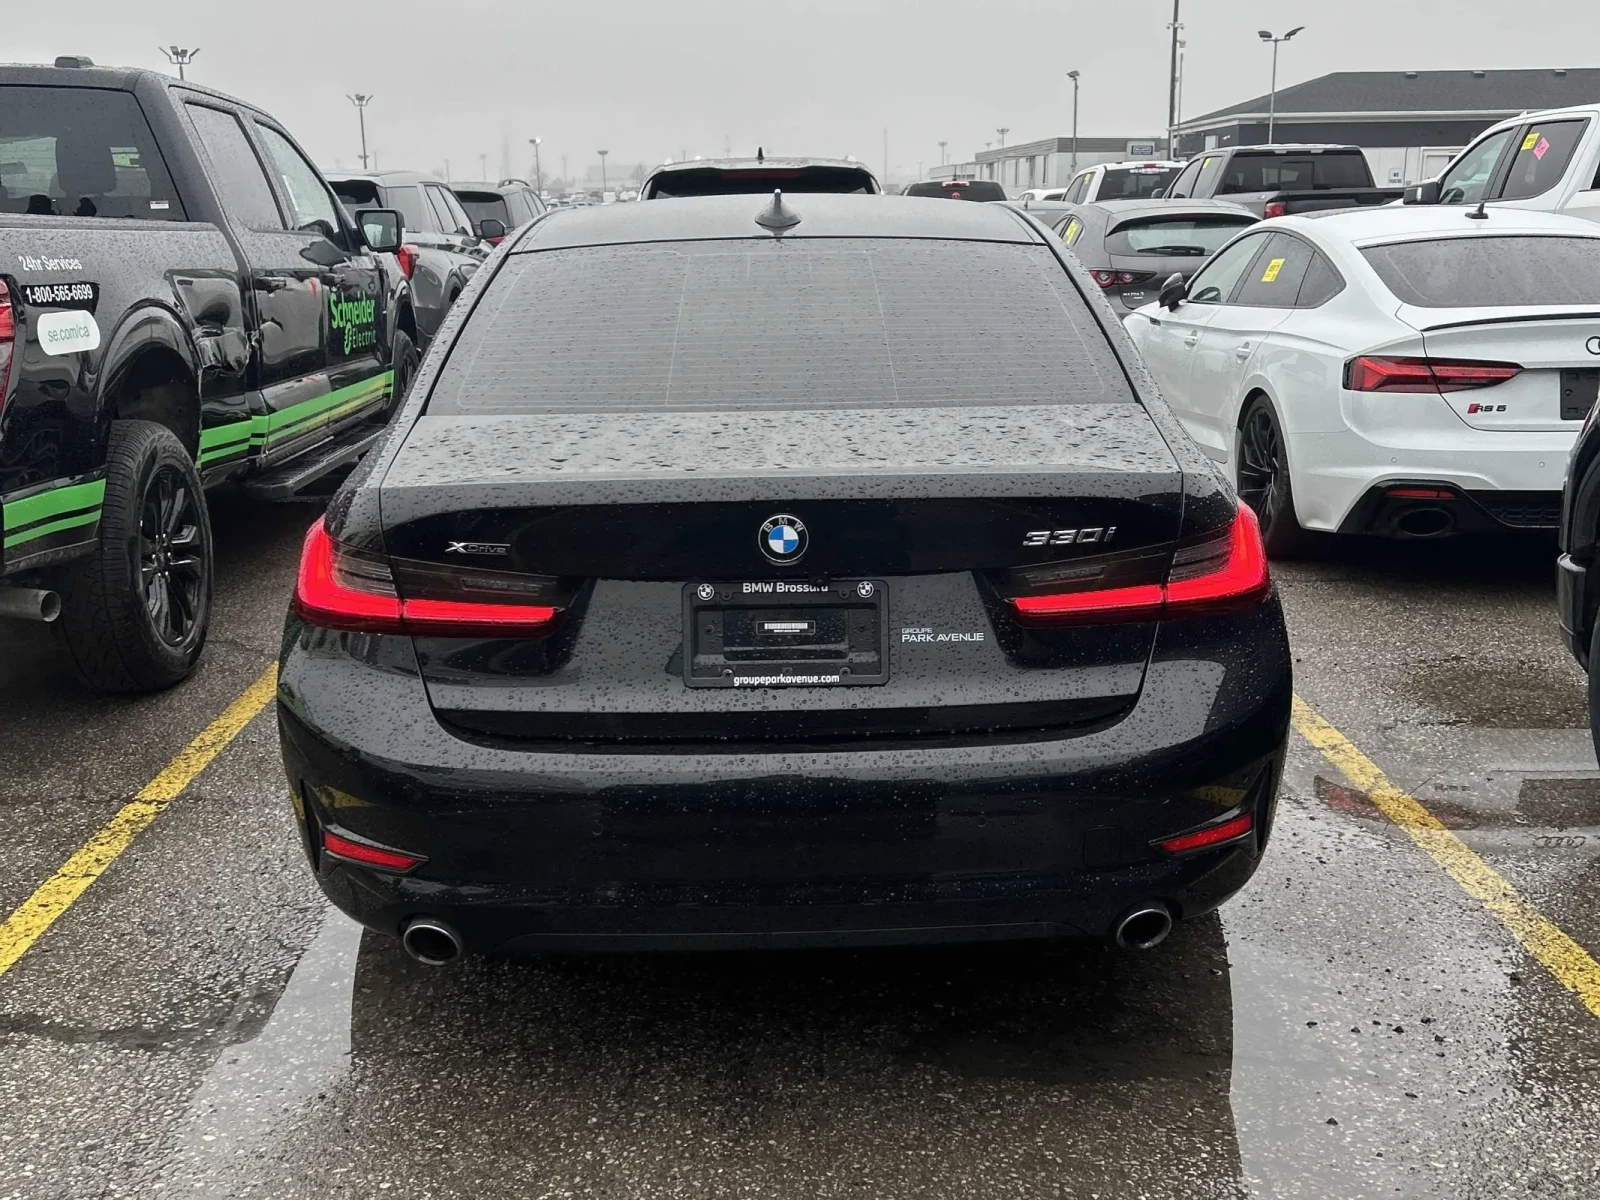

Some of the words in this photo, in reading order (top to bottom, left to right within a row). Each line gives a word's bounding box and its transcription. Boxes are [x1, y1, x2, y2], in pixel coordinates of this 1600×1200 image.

[18, 255, 43, 271] 24hr
[41, 254, 83, 271] Services
[25, 283, 94, 304] 1-800-565-6699
[330, 290, 375, 329] Schneider
[47, 323, 91, 342] se.com/ca
[352, 325, 377, 348] Electric
[1467, 403, 1495, 414] RS
[1496, 404, 1508, 412] 5
[763, 517, 805, 533] BMW
[1022, 526, 1118, 546] 330i
[742, 582, 774, 593] BMW
[776, 582, 829, 593] Brossad
[901, 633, 935, 643] PARK
[936, 632, 985, 642] AVENUE
[733, 673, 840, 687] groupeparkavenue.com
